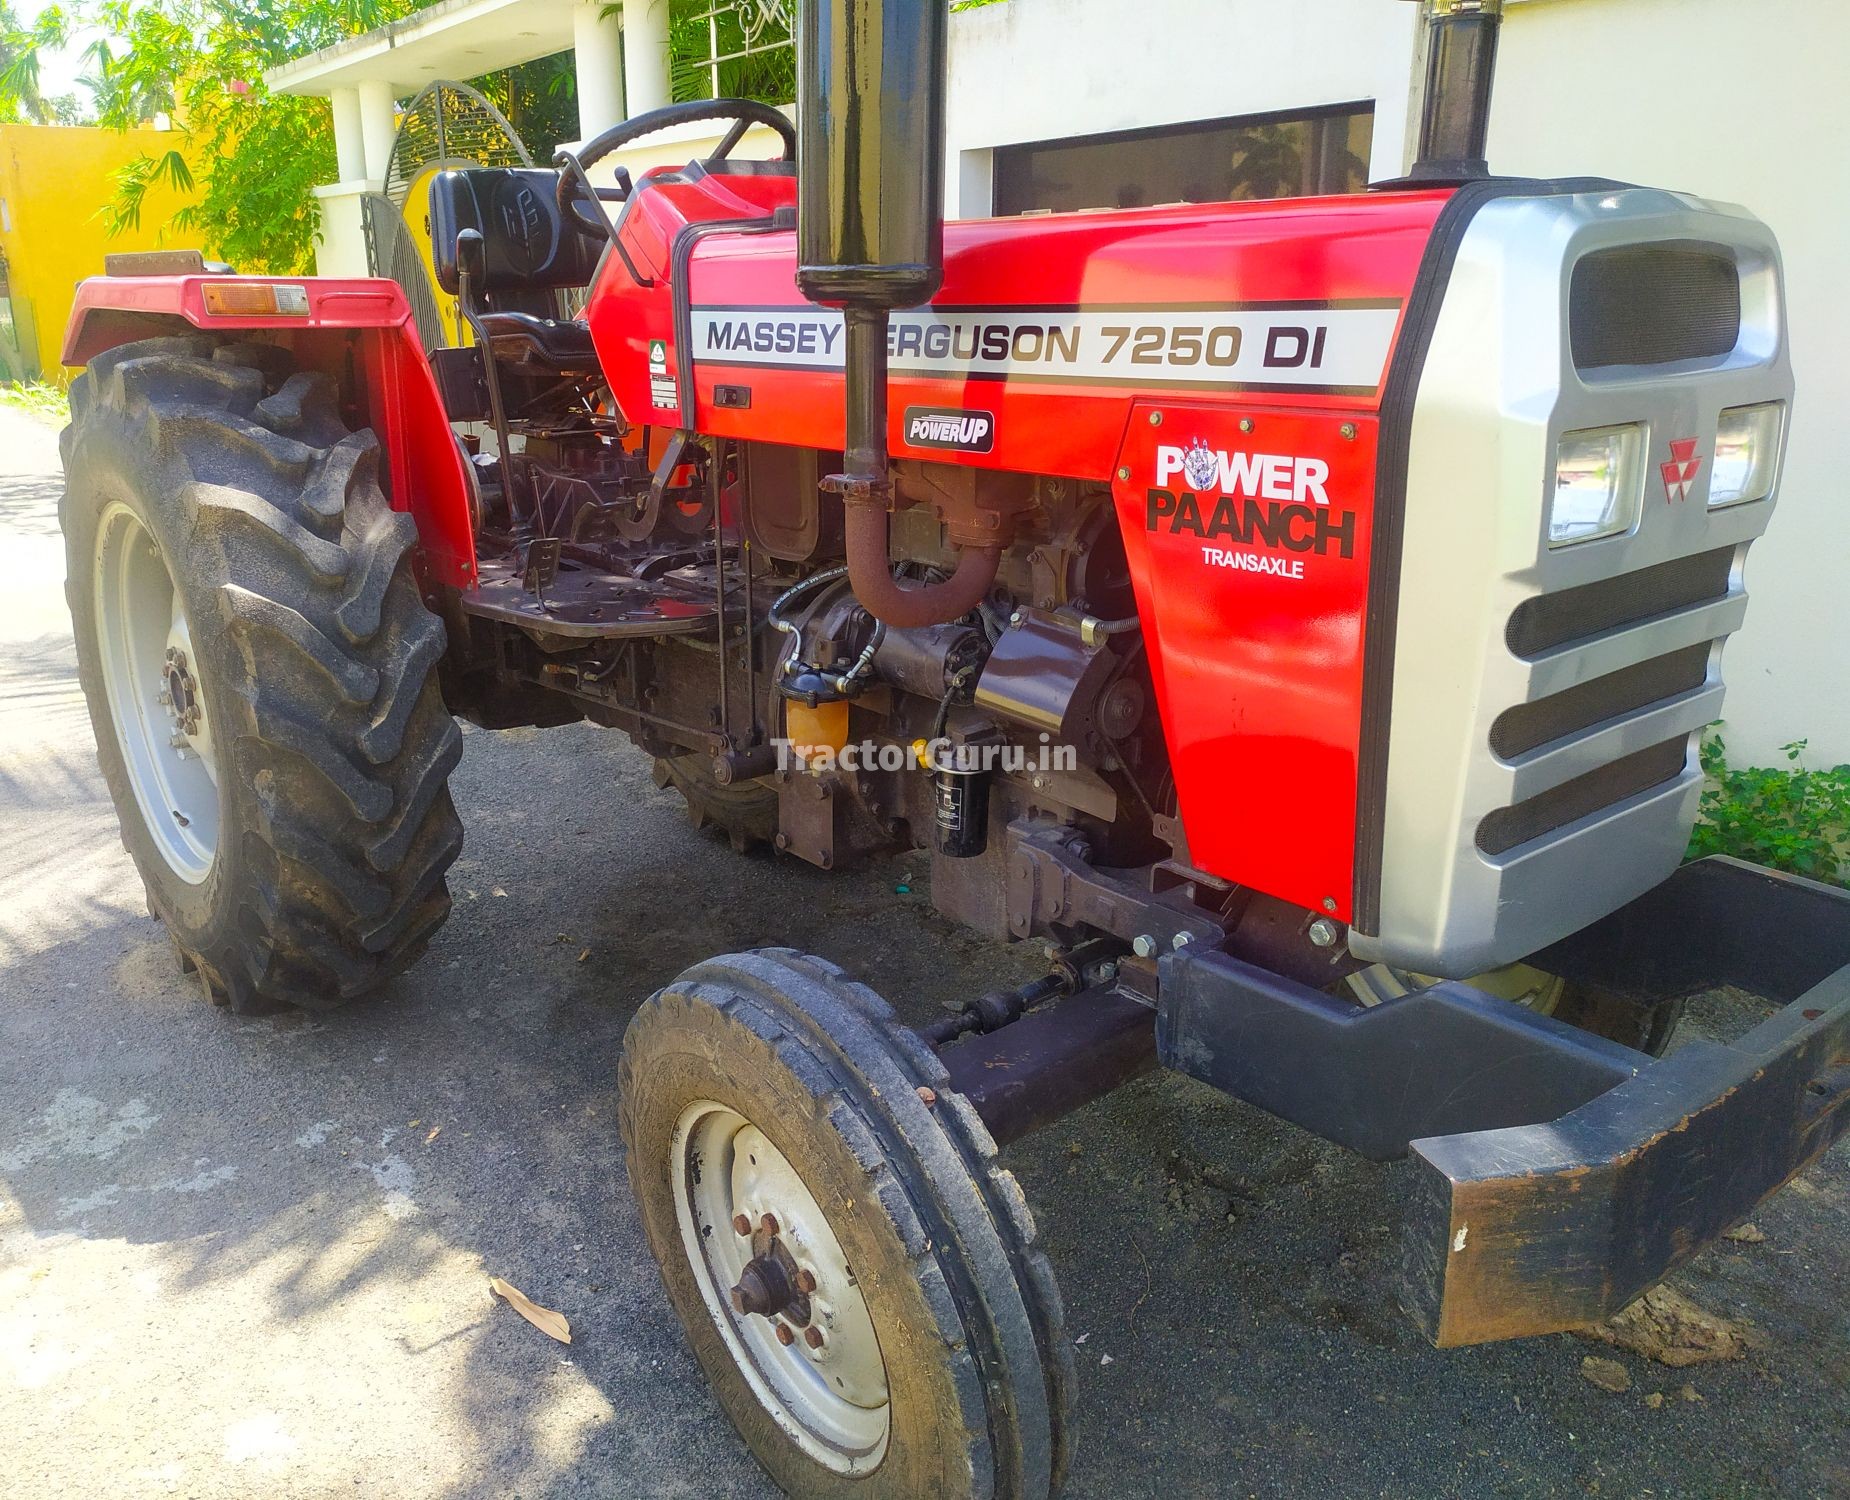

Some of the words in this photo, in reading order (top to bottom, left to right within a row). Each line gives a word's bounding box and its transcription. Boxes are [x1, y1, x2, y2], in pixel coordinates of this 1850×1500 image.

[706, 321, 842, 355] MASSEY
[887, 324, 1081, 363] RGUSON
[1100, 326, 1242, 367] 7250
[1262, 326, 1327, 368] DI
[1156, 444, 1330, 505] POWER
[1146, 488, 1356, 560] PAANCH
[1202, 547, 1304, 580] TRANSAXLE
